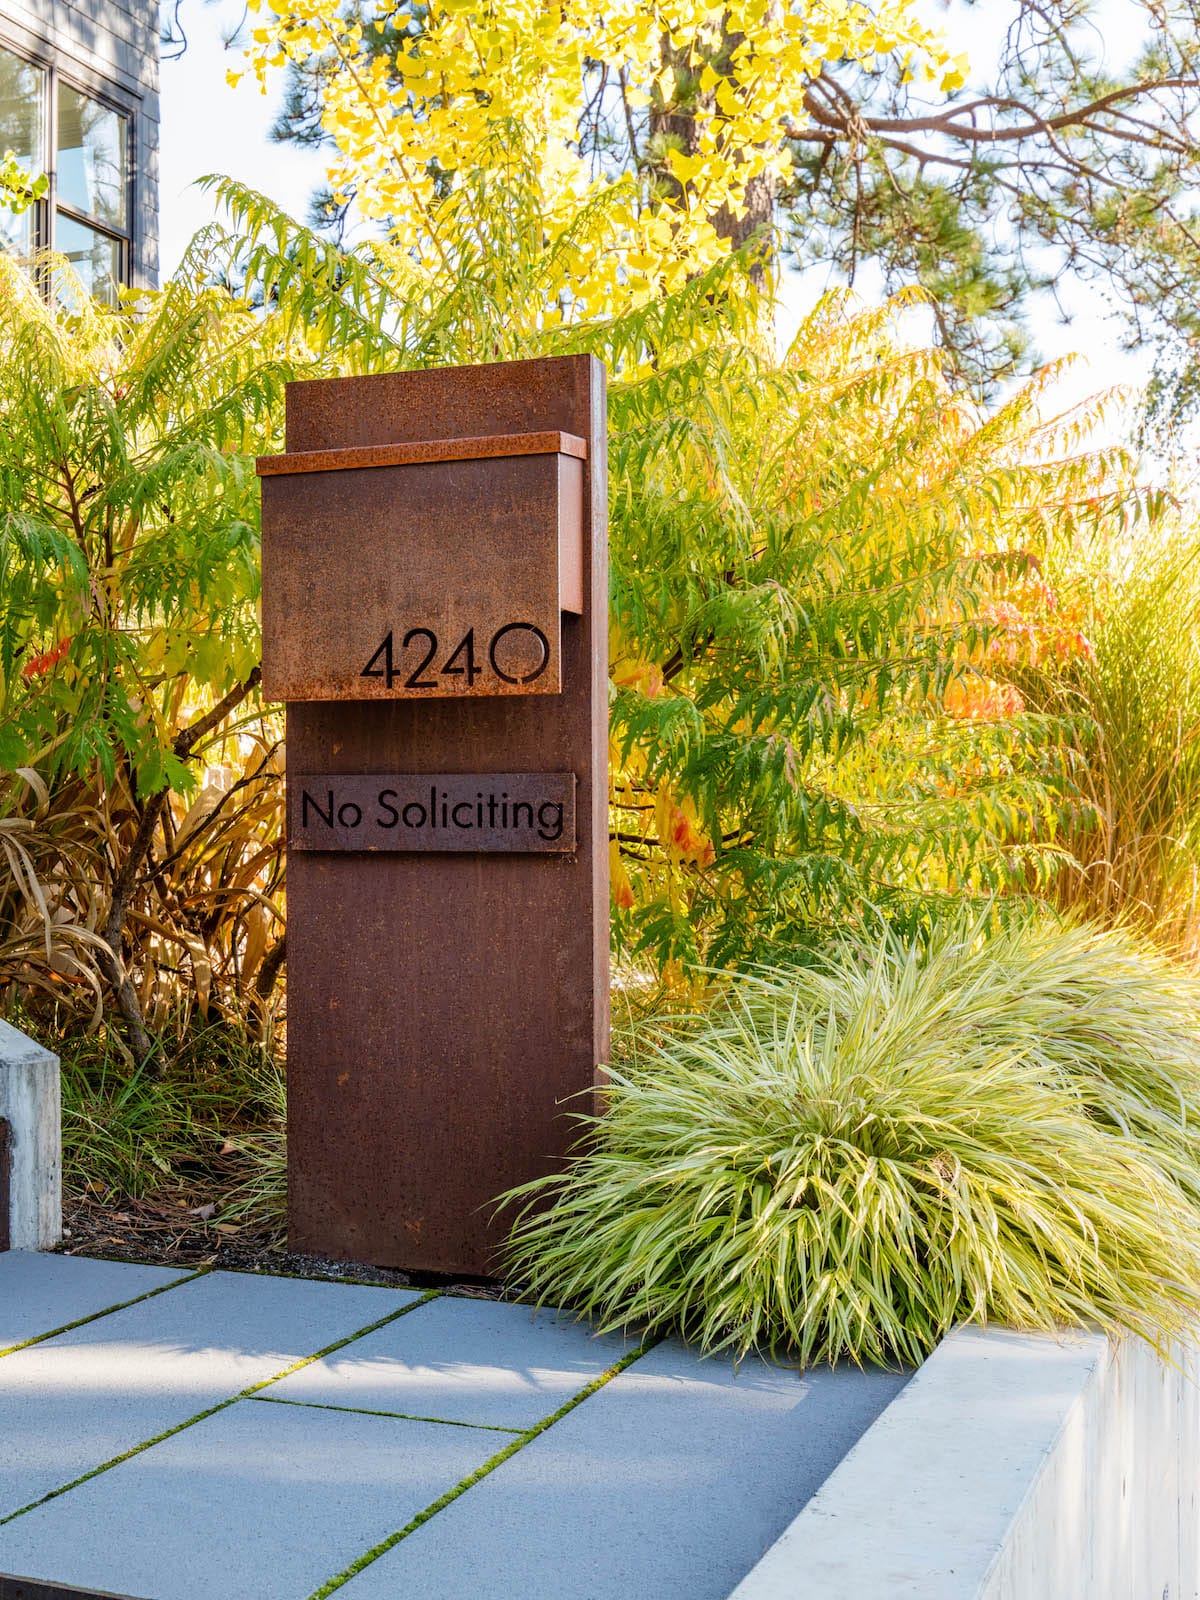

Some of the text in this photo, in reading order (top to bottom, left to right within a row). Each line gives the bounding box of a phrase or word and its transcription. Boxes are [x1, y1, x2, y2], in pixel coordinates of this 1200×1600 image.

[360, 621, 551, 689] 4240
[301, 786, 564, 841] No Soliciting
